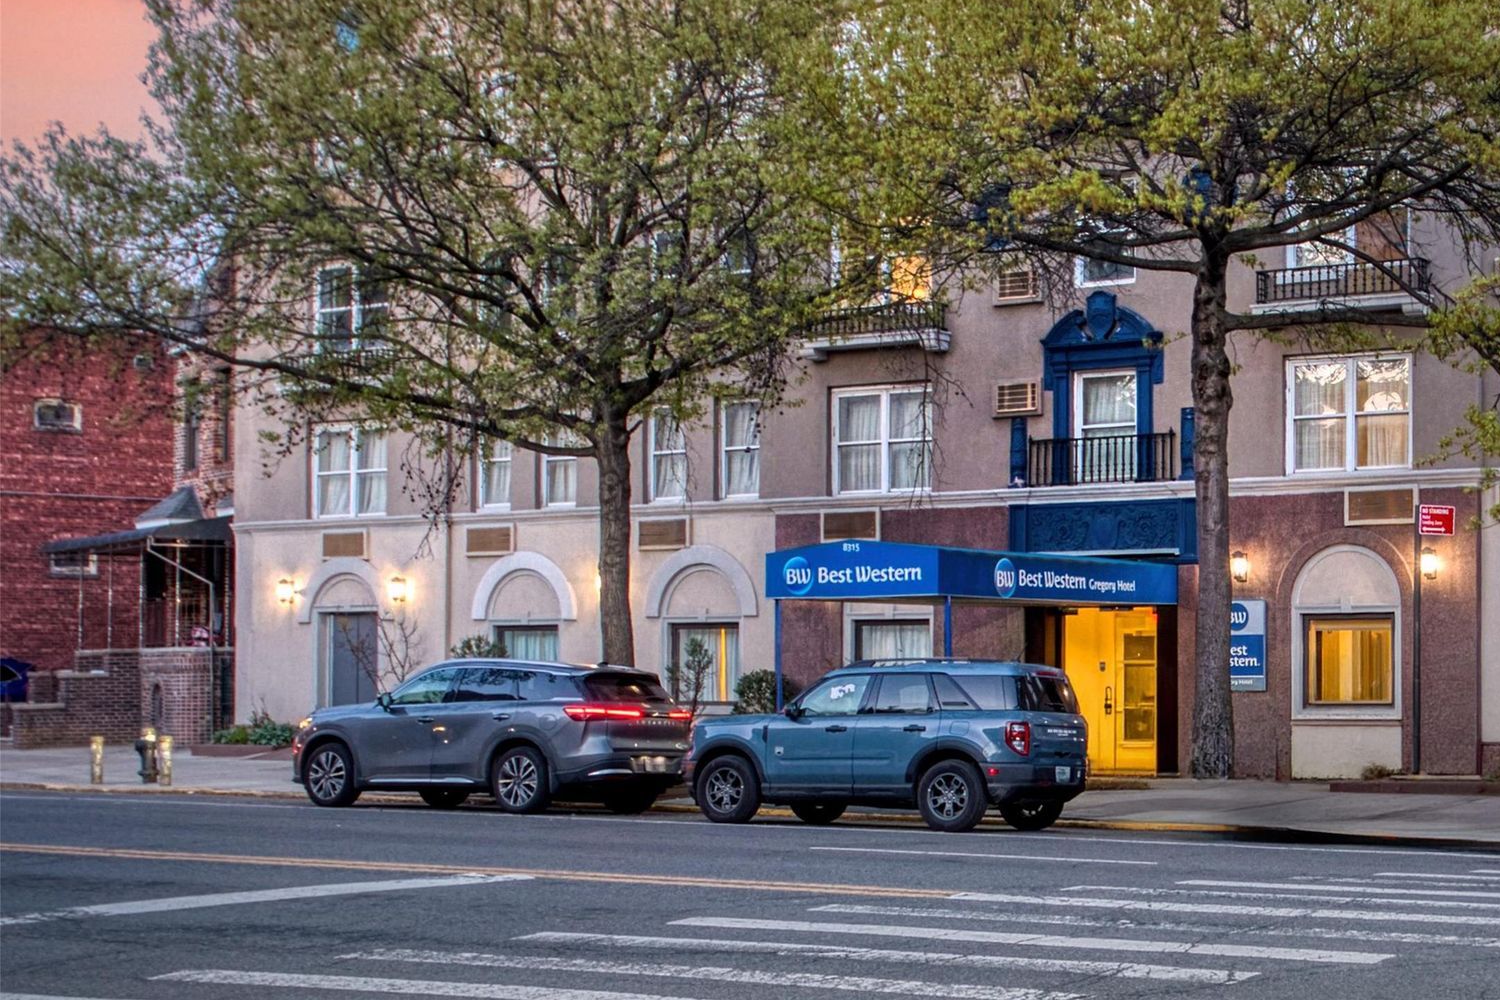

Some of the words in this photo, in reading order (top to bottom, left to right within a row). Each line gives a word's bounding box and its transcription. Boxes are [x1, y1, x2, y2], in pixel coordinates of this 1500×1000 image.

[842, 543, 860, 552] 8315
[786, 568, 811, 585] BW
[817, 566, 853, 584] Best
[855, 565, 922, 583] Western
[996, 570, 1015, 588] BW
[1018, 569, 1043, 588] Best
[1043, 571, 1087, 590] Western
[1088, 578, 1116, 593] Gregory
[1116, 580, 1136, 592] Hotel
[1230, 645, 1248, 656] est
